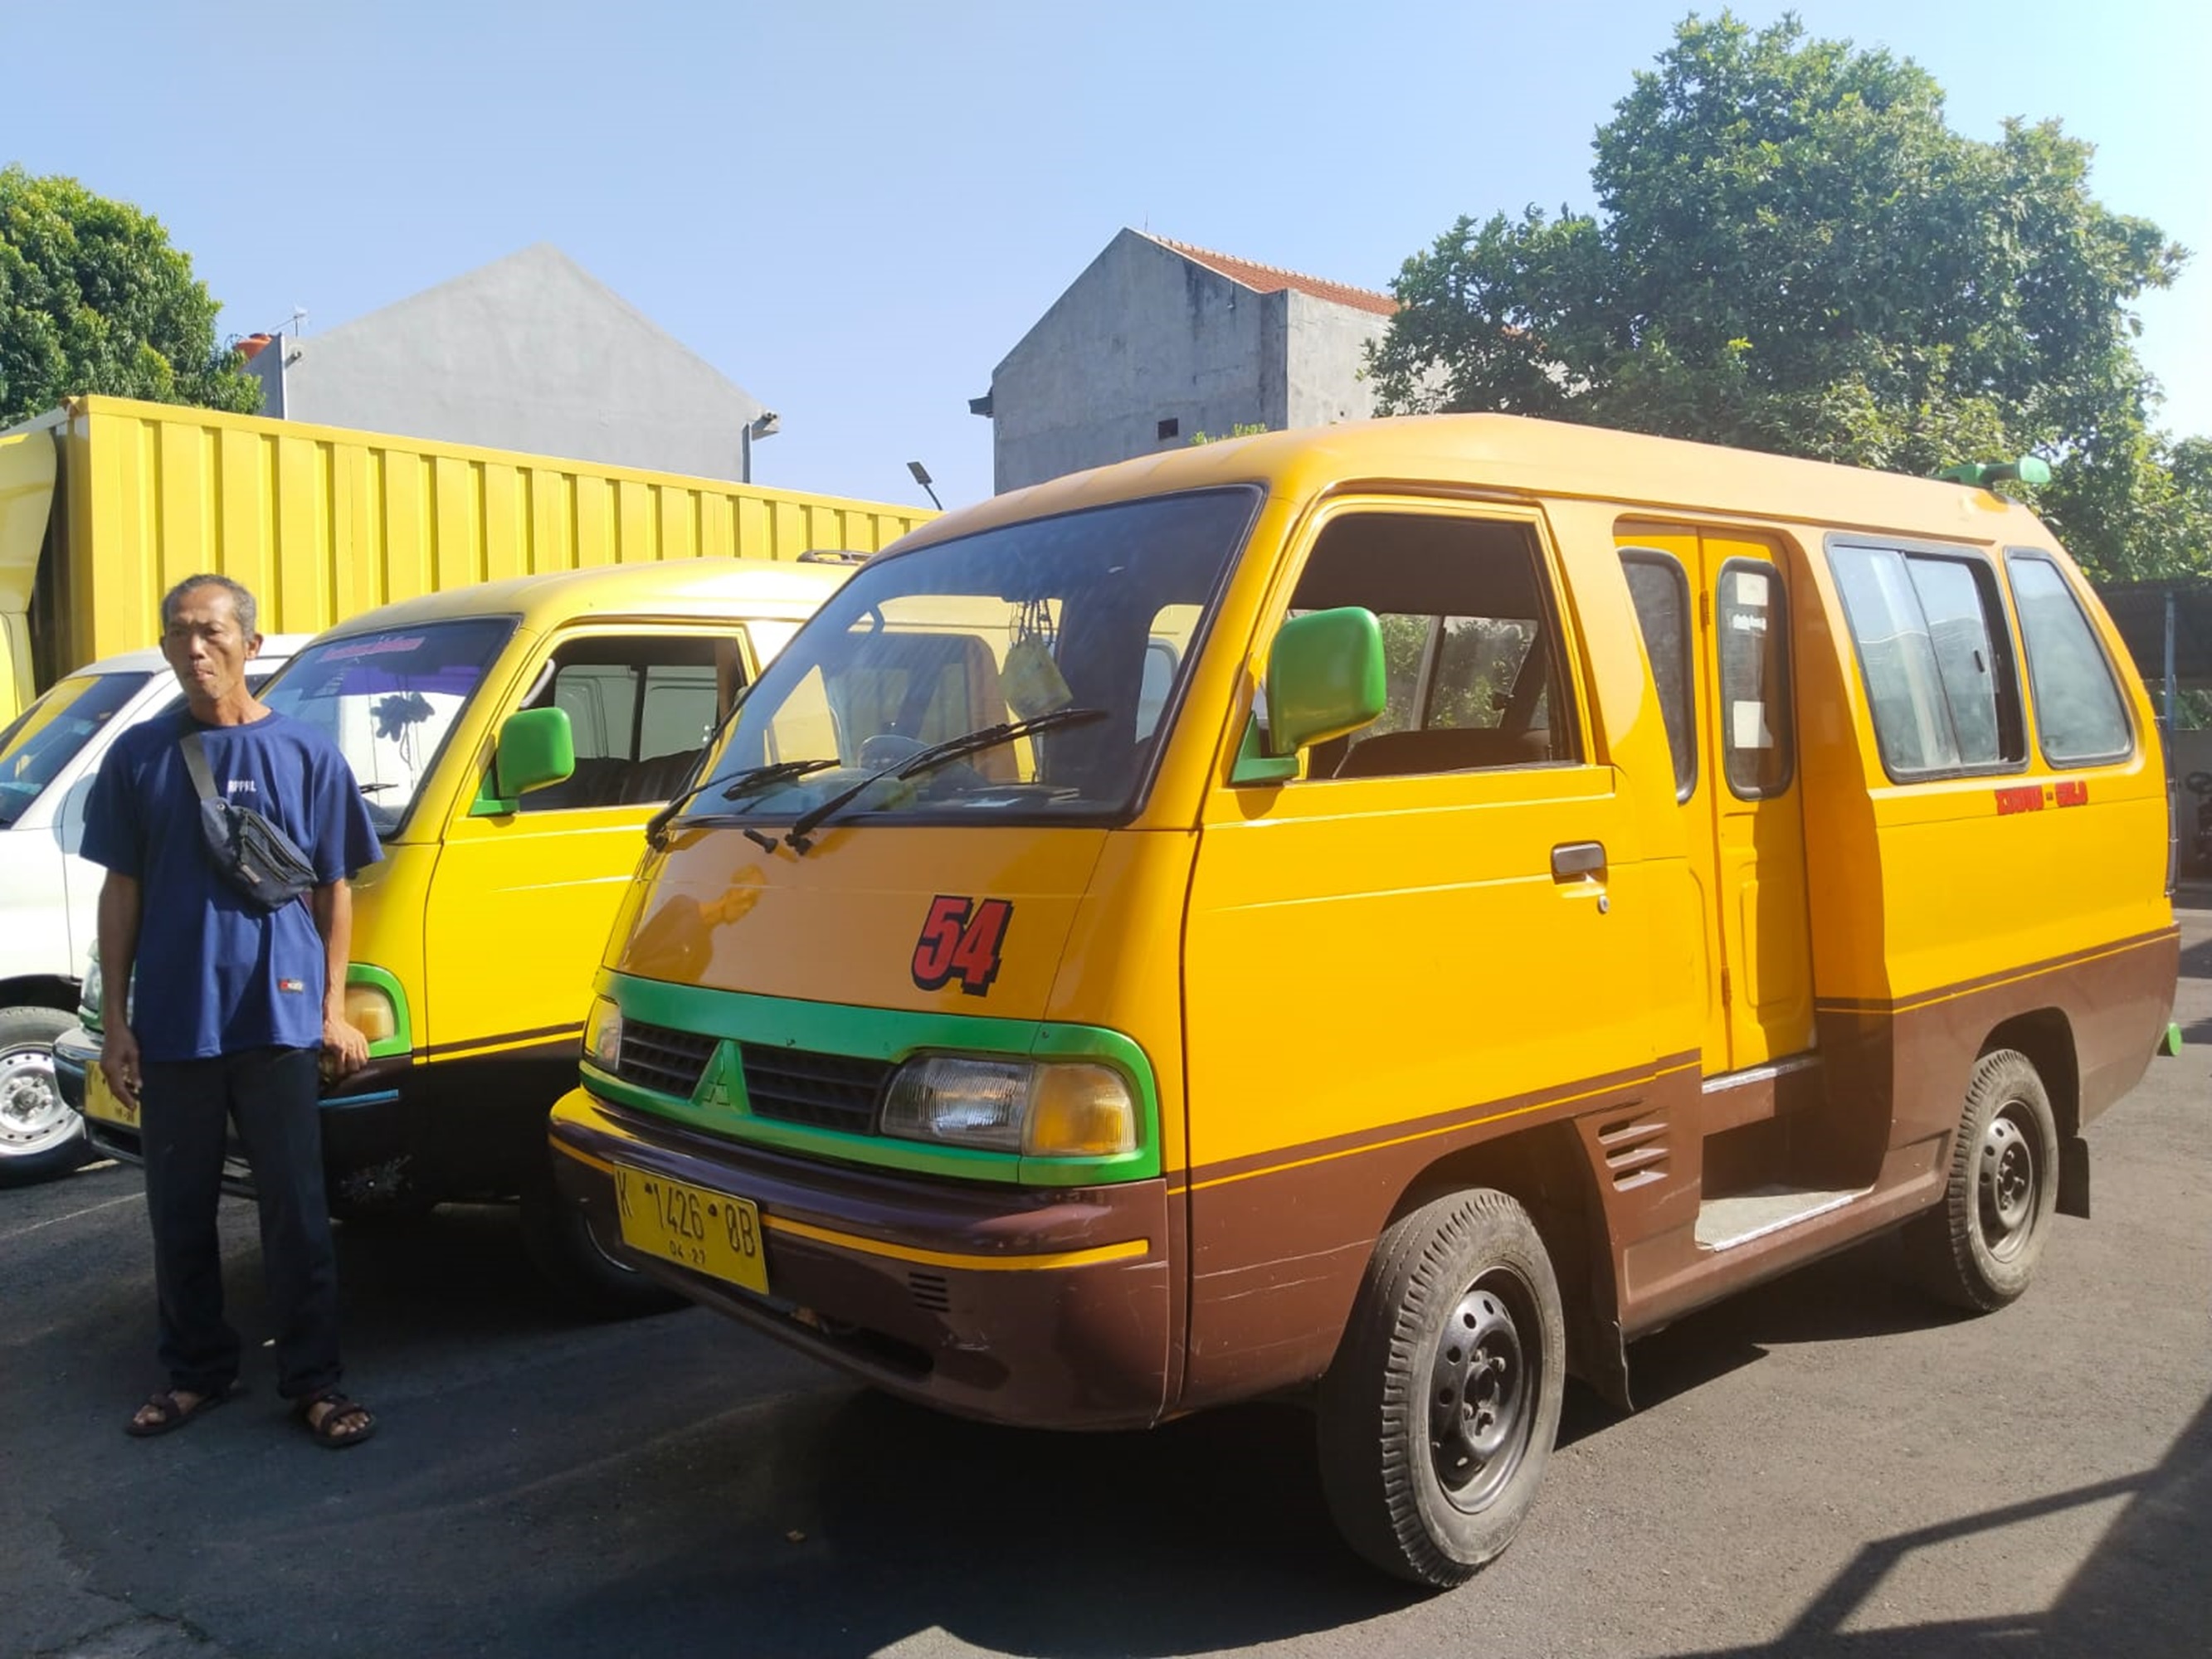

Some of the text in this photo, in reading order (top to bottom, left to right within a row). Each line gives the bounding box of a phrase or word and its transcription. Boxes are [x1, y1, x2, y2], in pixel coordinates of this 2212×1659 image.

[911, 894, 1014, 997] 54
[617, 1170, 633, 1219] K
[653, 1183, 704, 1240] 1426
